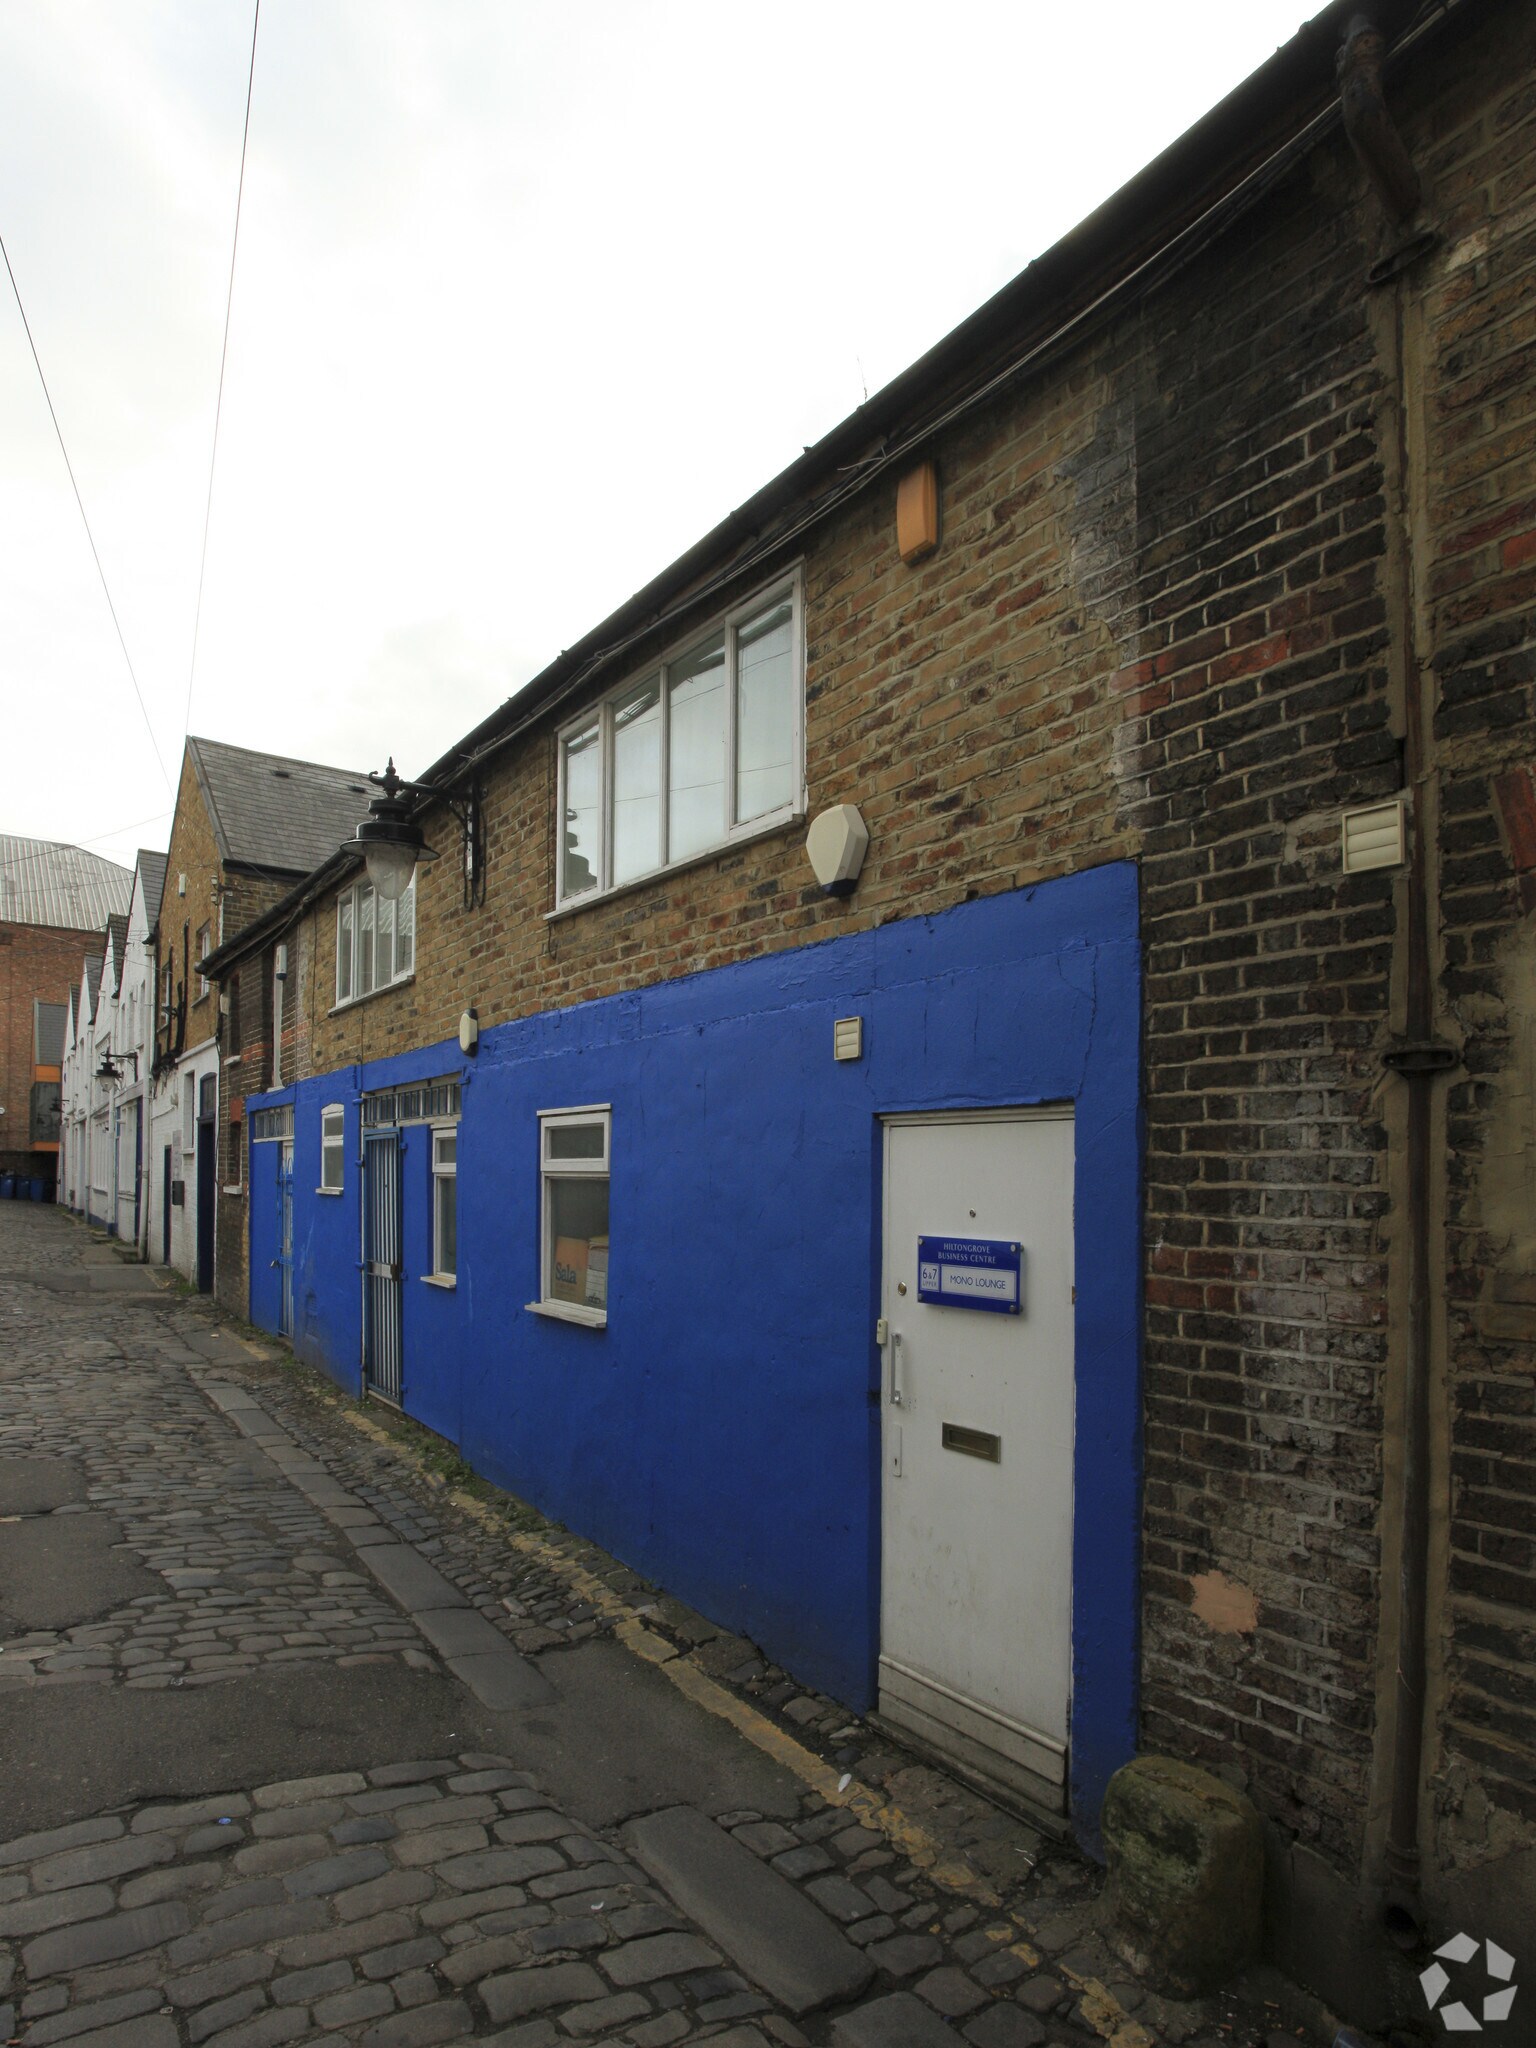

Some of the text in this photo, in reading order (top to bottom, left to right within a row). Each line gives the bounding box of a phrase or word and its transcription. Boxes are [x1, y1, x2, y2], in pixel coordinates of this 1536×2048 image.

[943, 1243, 990, 1254] HILTONGROVE
[938, 1252, 996, 1264] BUSINESS CENTRE
[950, 1275, 1006, 1290] MONO LOUNGE
